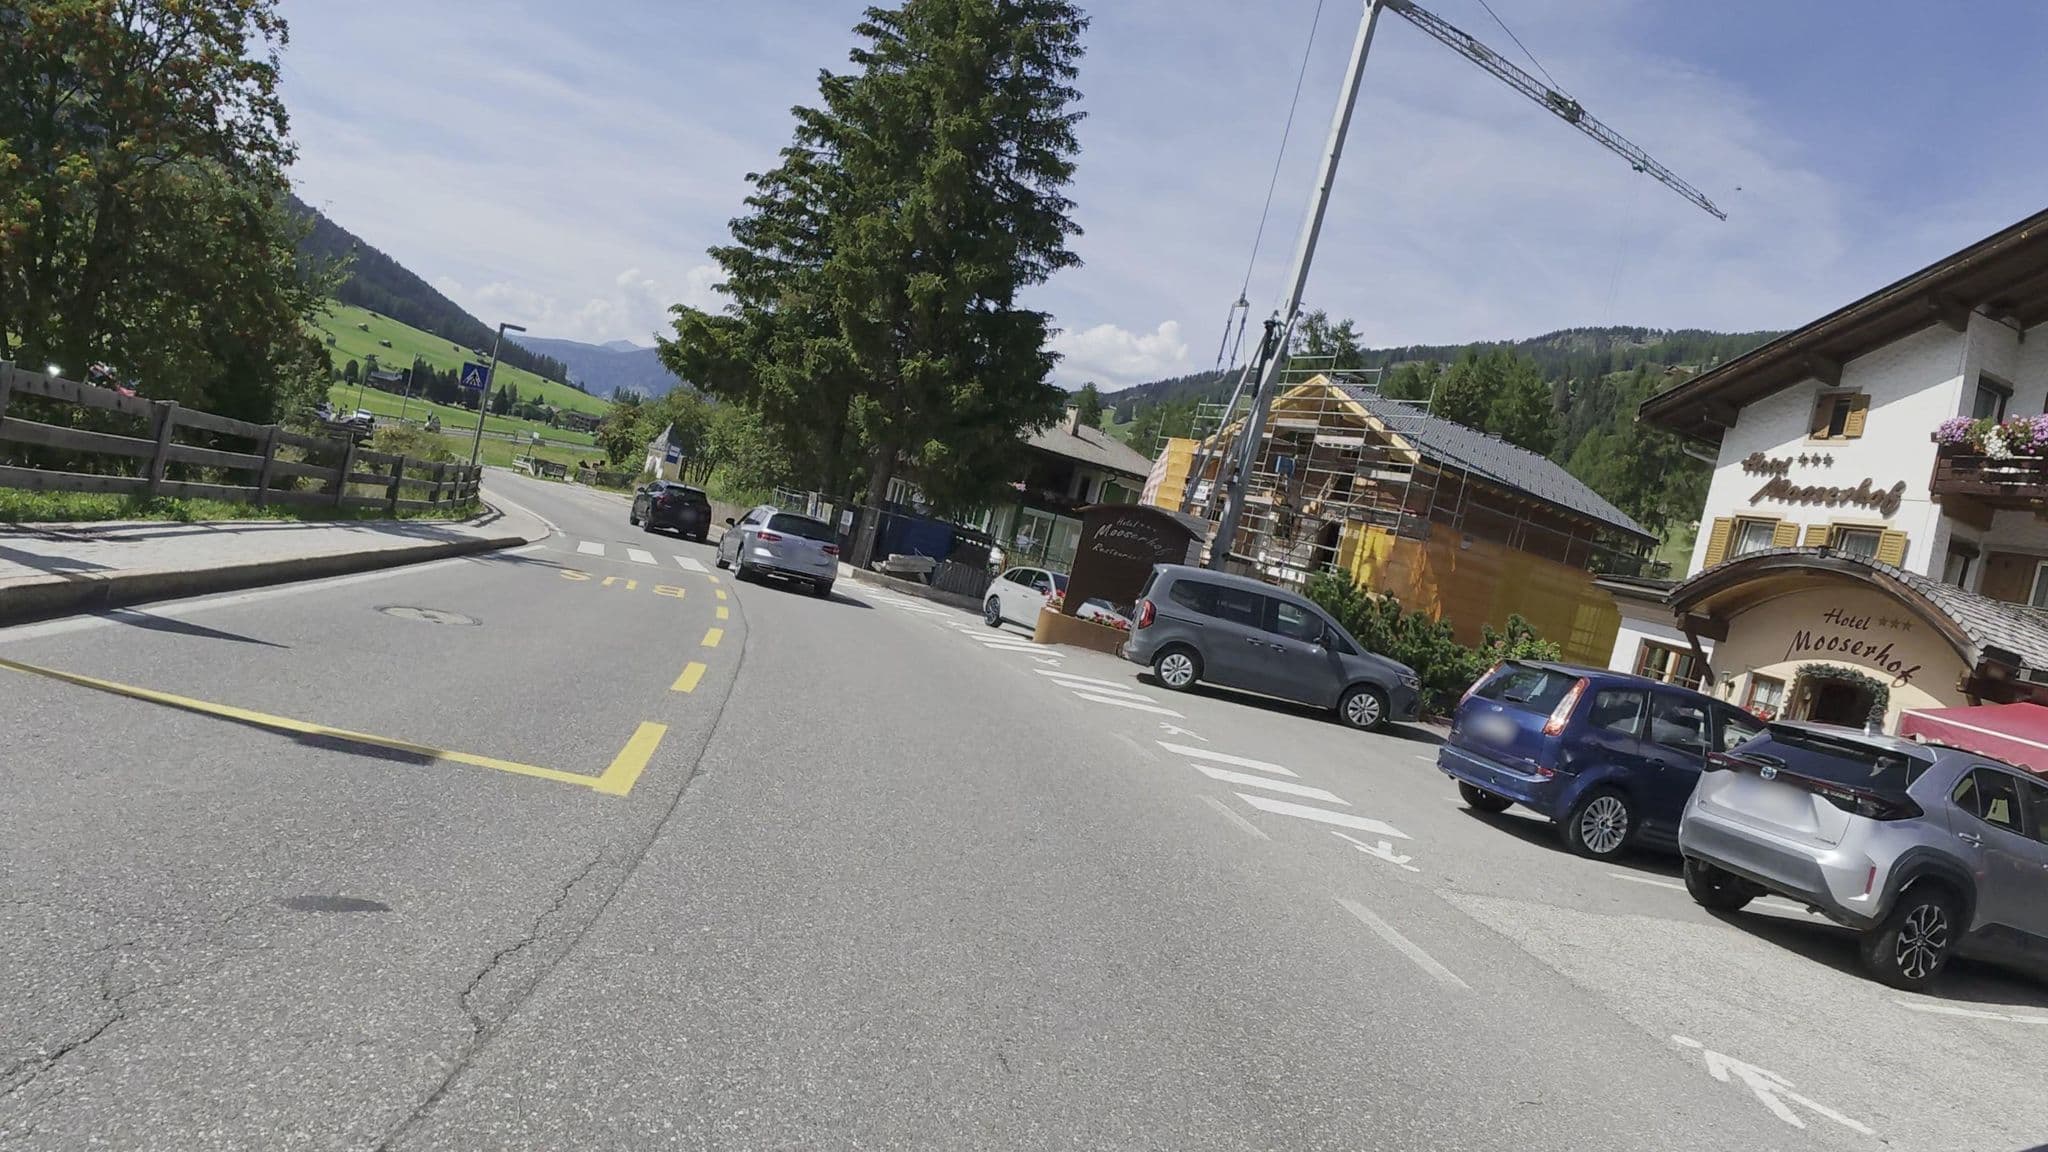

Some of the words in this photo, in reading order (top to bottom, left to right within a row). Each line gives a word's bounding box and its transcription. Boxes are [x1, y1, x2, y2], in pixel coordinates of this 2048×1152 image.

[1748, 476, 1906, 518] Mooserhof
[1093, 522, 1176, 557] Mooserhof
[560, 569, 686, 599] BUS
[1823, 608, 1871, 631] Hotel
[1783, 630, 1922, 688] Mooserhof
